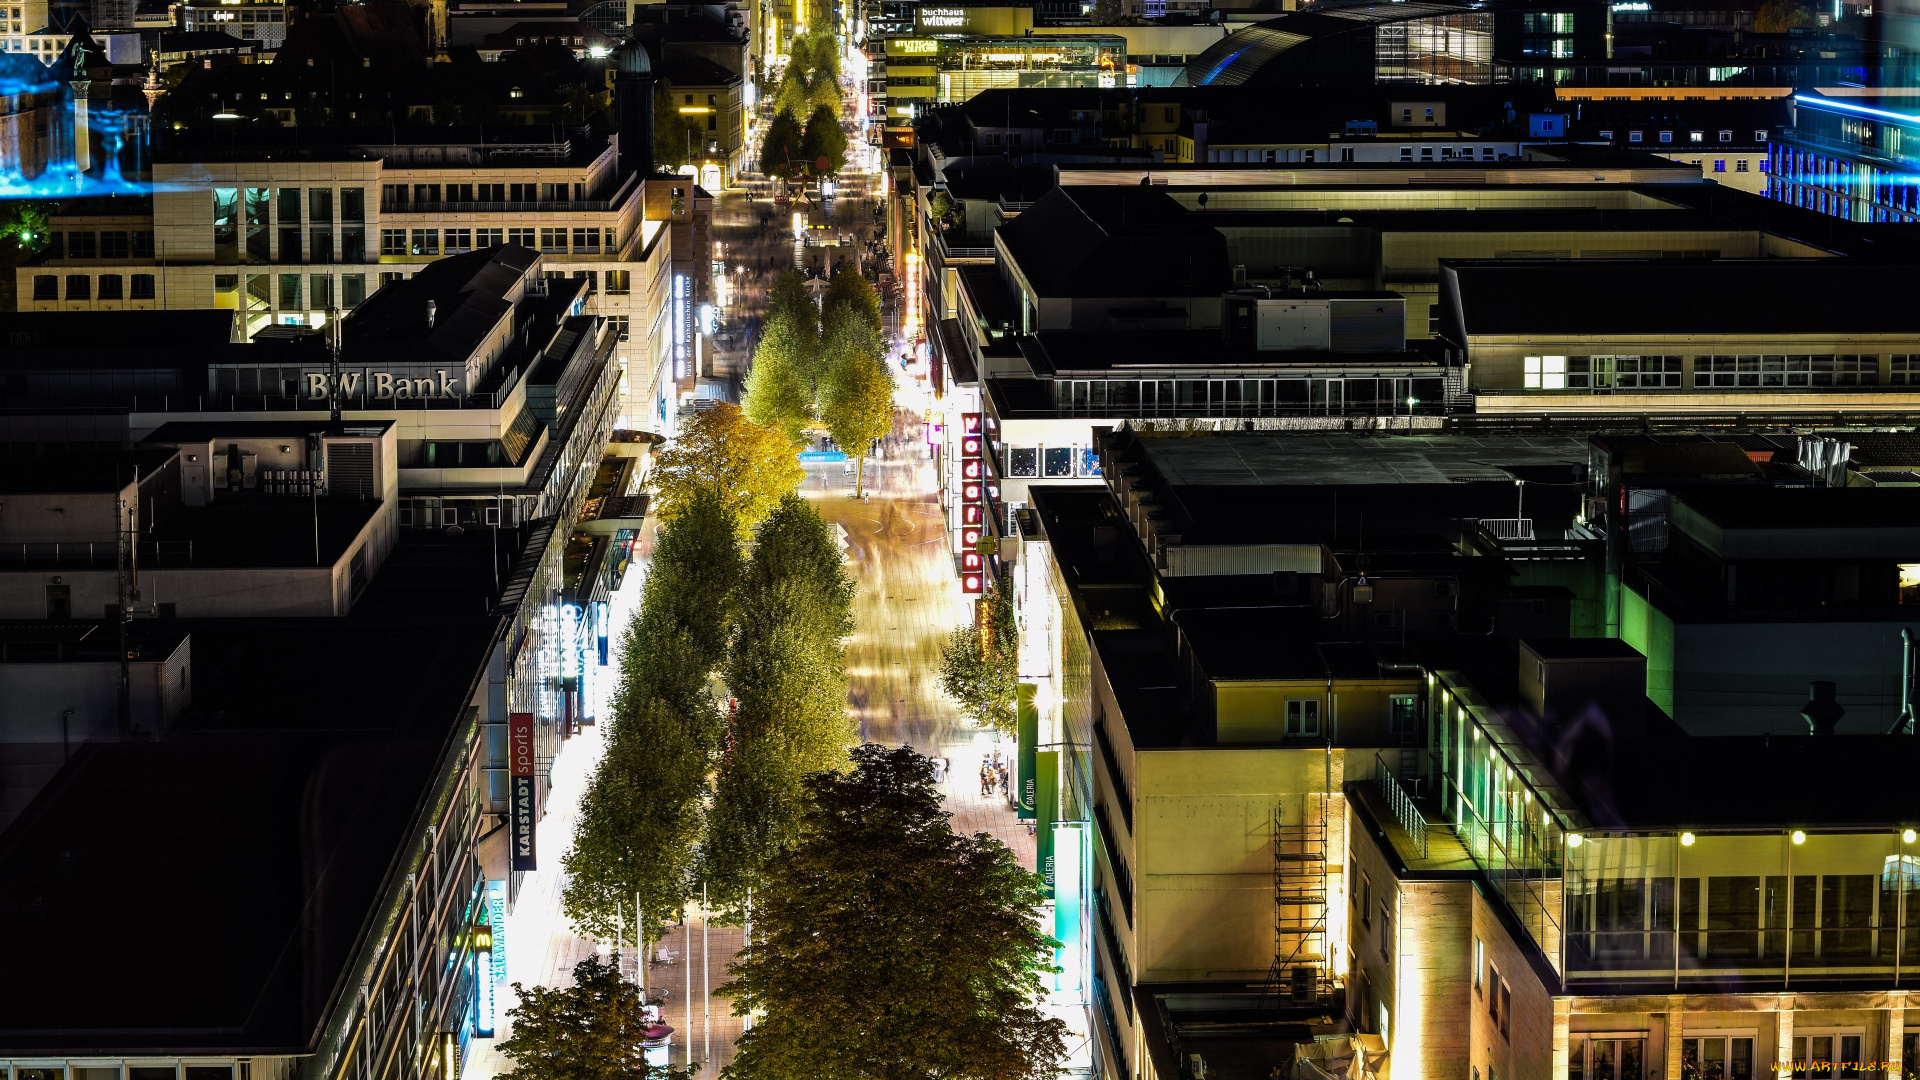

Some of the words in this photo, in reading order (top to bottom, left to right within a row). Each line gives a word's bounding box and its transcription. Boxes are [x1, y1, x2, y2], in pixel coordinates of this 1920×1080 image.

[922, 8, 965, 16] buchhaus
[373, 370, 460, 400] Bank
[514, 726, 532, 773] sports
[1026, 778, 1035, 805] GALERIA
[518, 778, 530, 857] KARSTADT
[1045, 855, 1054, 884] GALERIA
[492, 898, 504, 981] SALAMANDER
